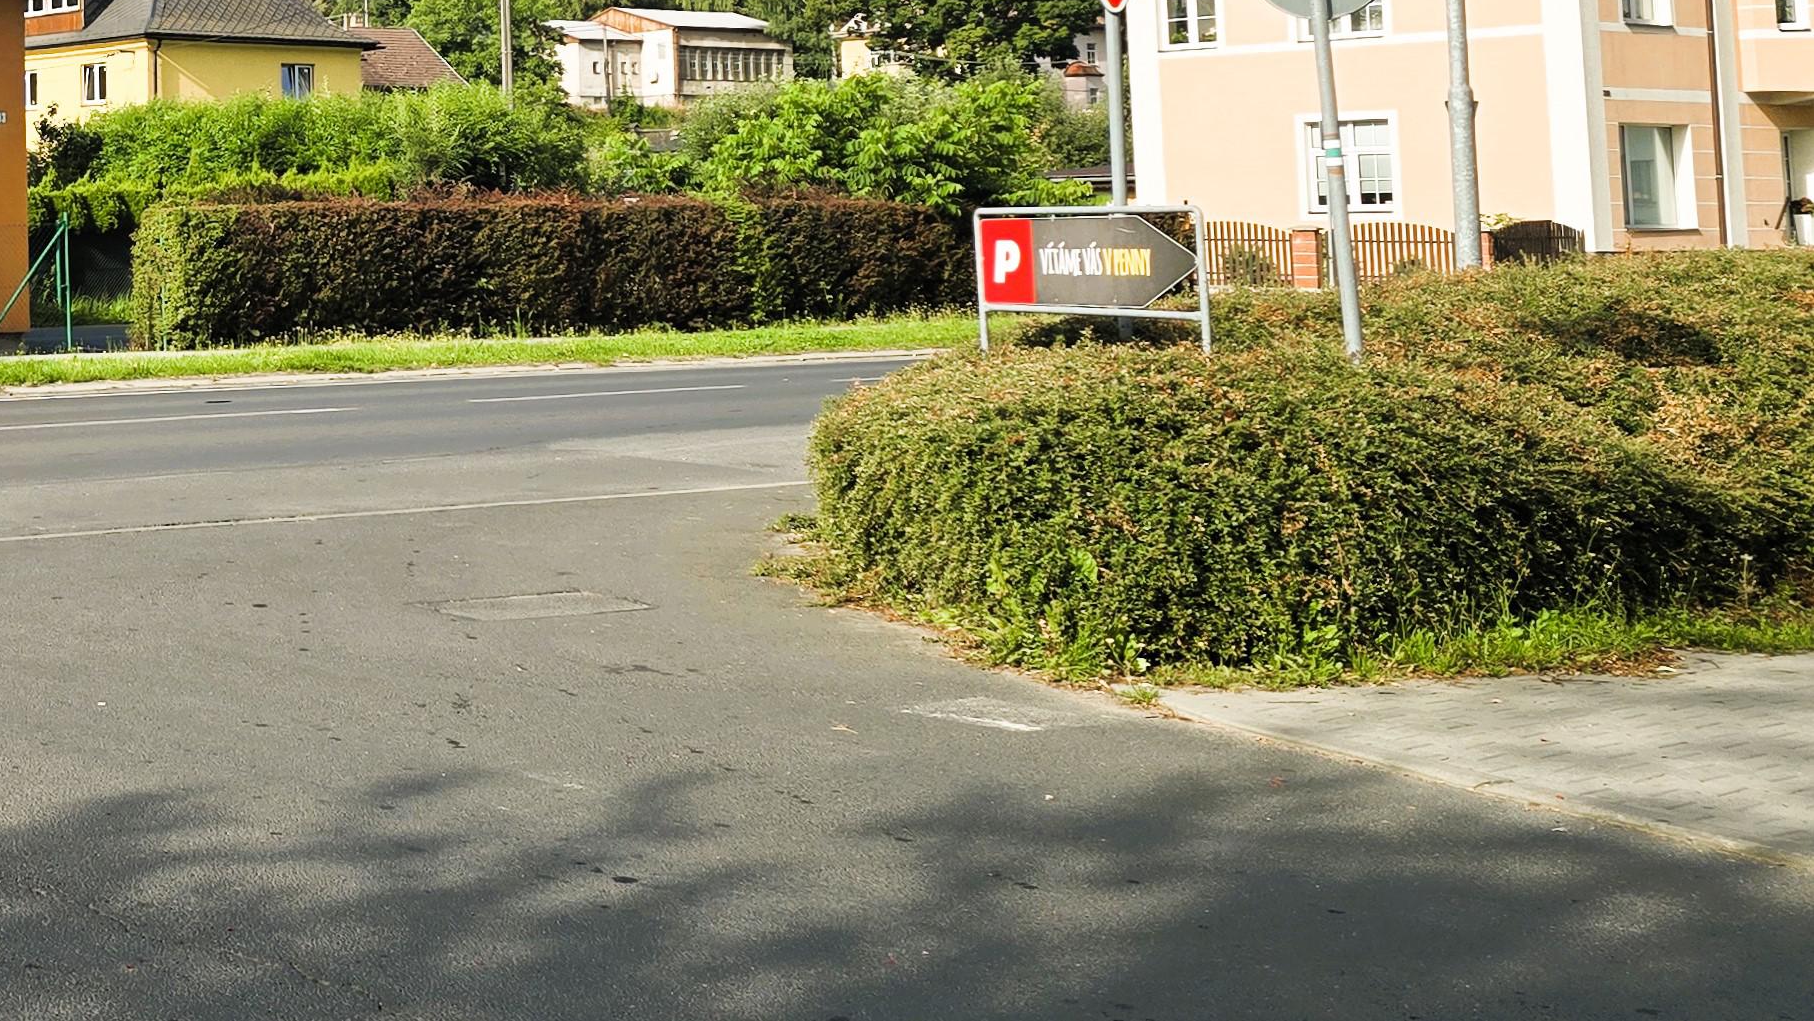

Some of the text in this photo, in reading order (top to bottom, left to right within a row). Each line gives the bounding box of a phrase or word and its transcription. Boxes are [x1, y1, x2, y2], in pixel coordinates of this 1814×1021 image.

[993, 239, 1021, 284] P
[1039, 241, 1151, 277] VÍTÁME VÁS V PENNY
